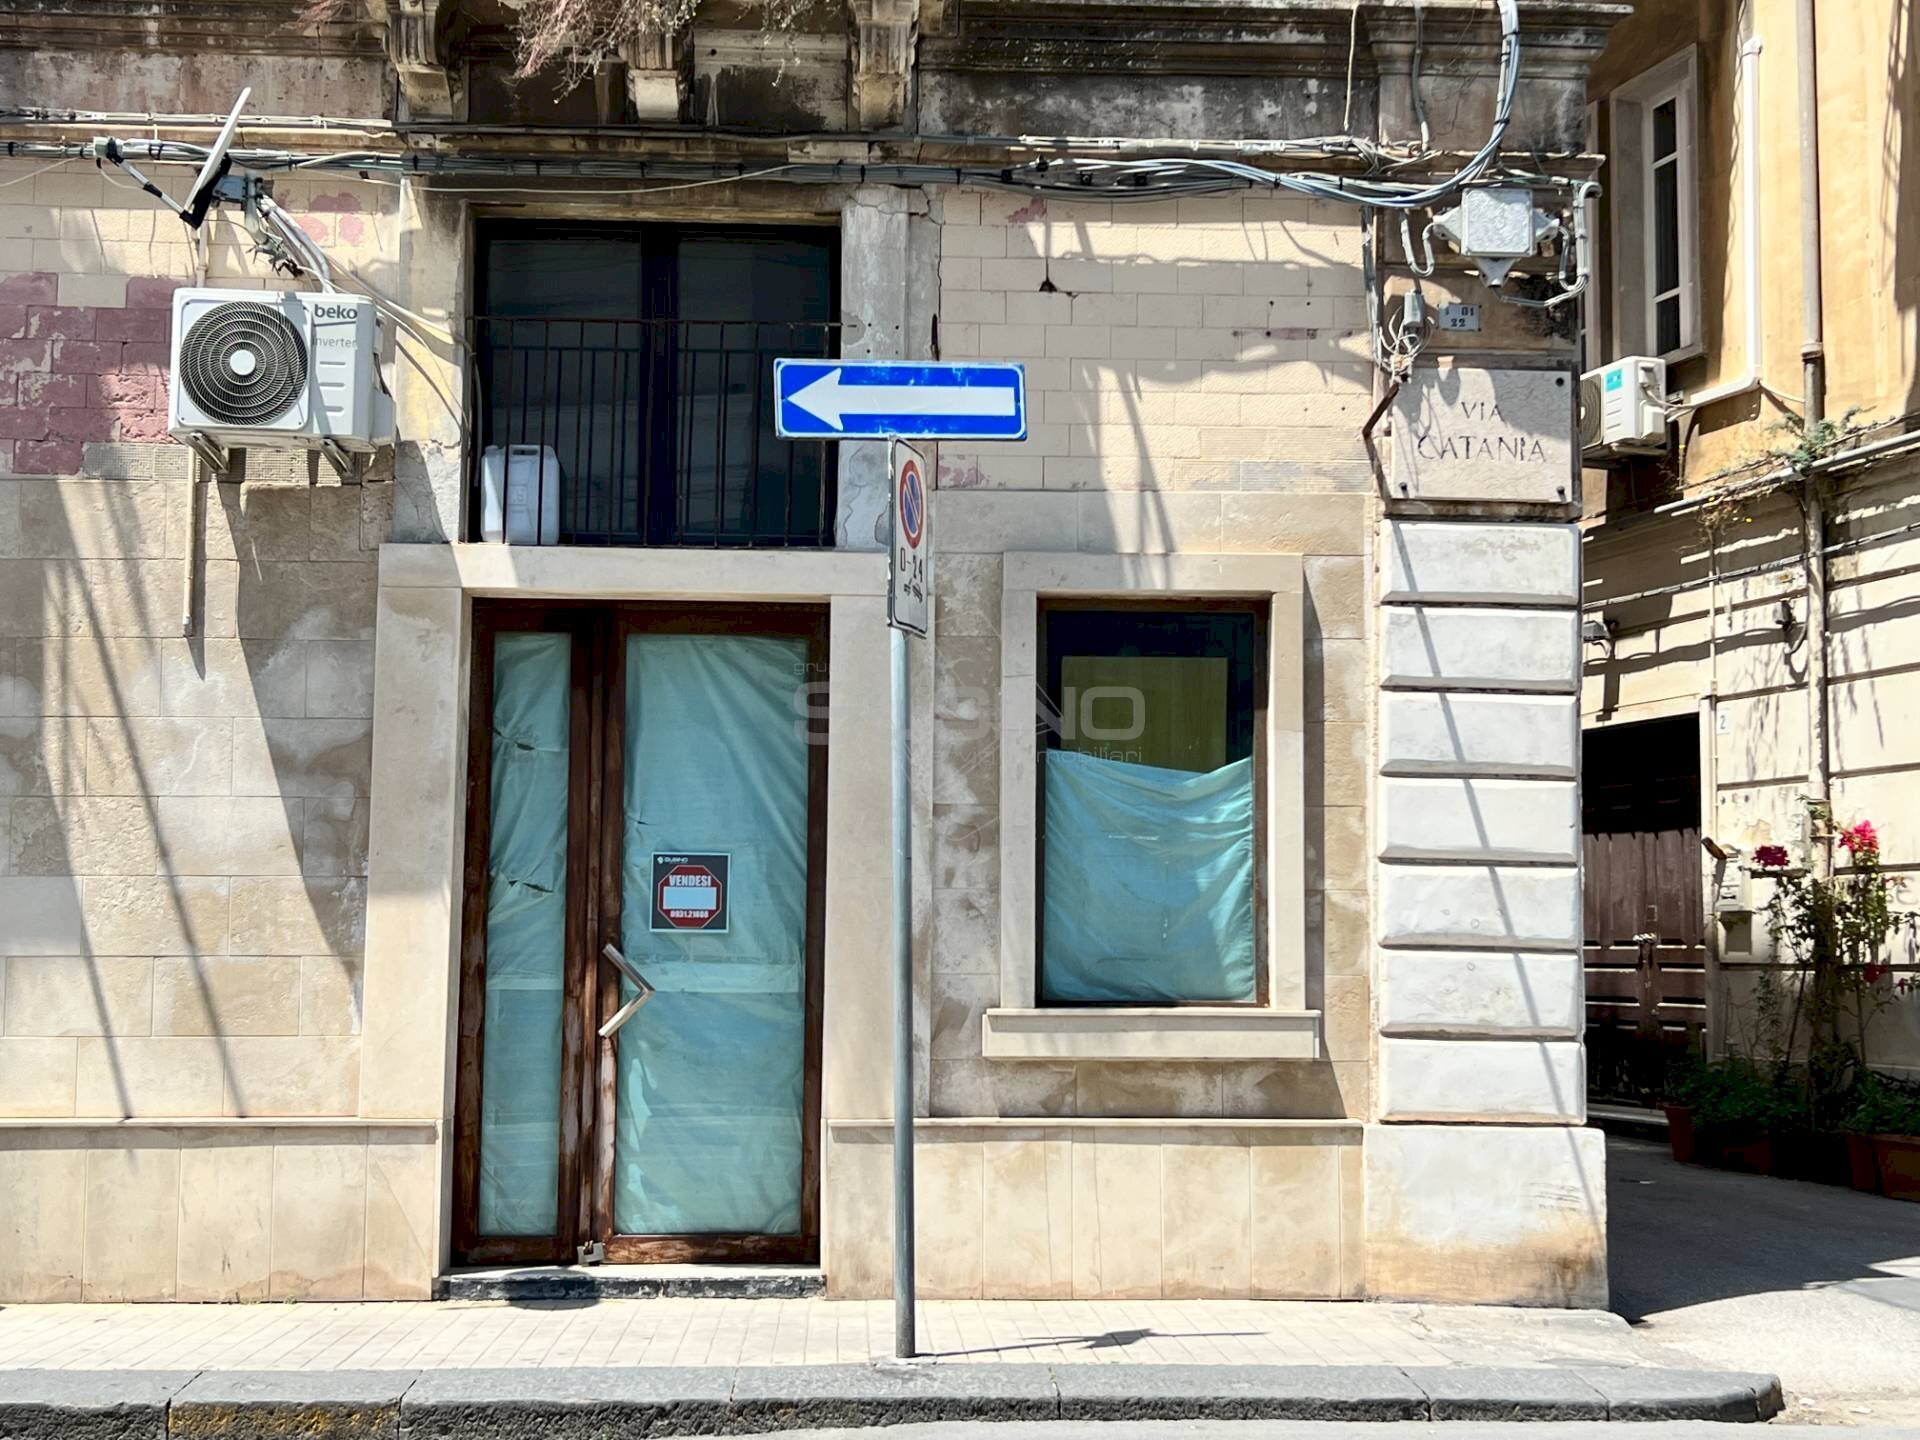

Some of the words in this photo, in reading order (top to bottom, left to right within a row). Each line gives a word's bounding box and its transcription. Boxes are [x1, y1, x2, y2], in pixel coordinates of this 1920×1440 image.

[314, 304, 358, 319] beko
[1461, 402, 1506, 422] VIA
[1418, 435, 1546, 461] CATANIA
[668, 874, 711, 887] VENDESI
